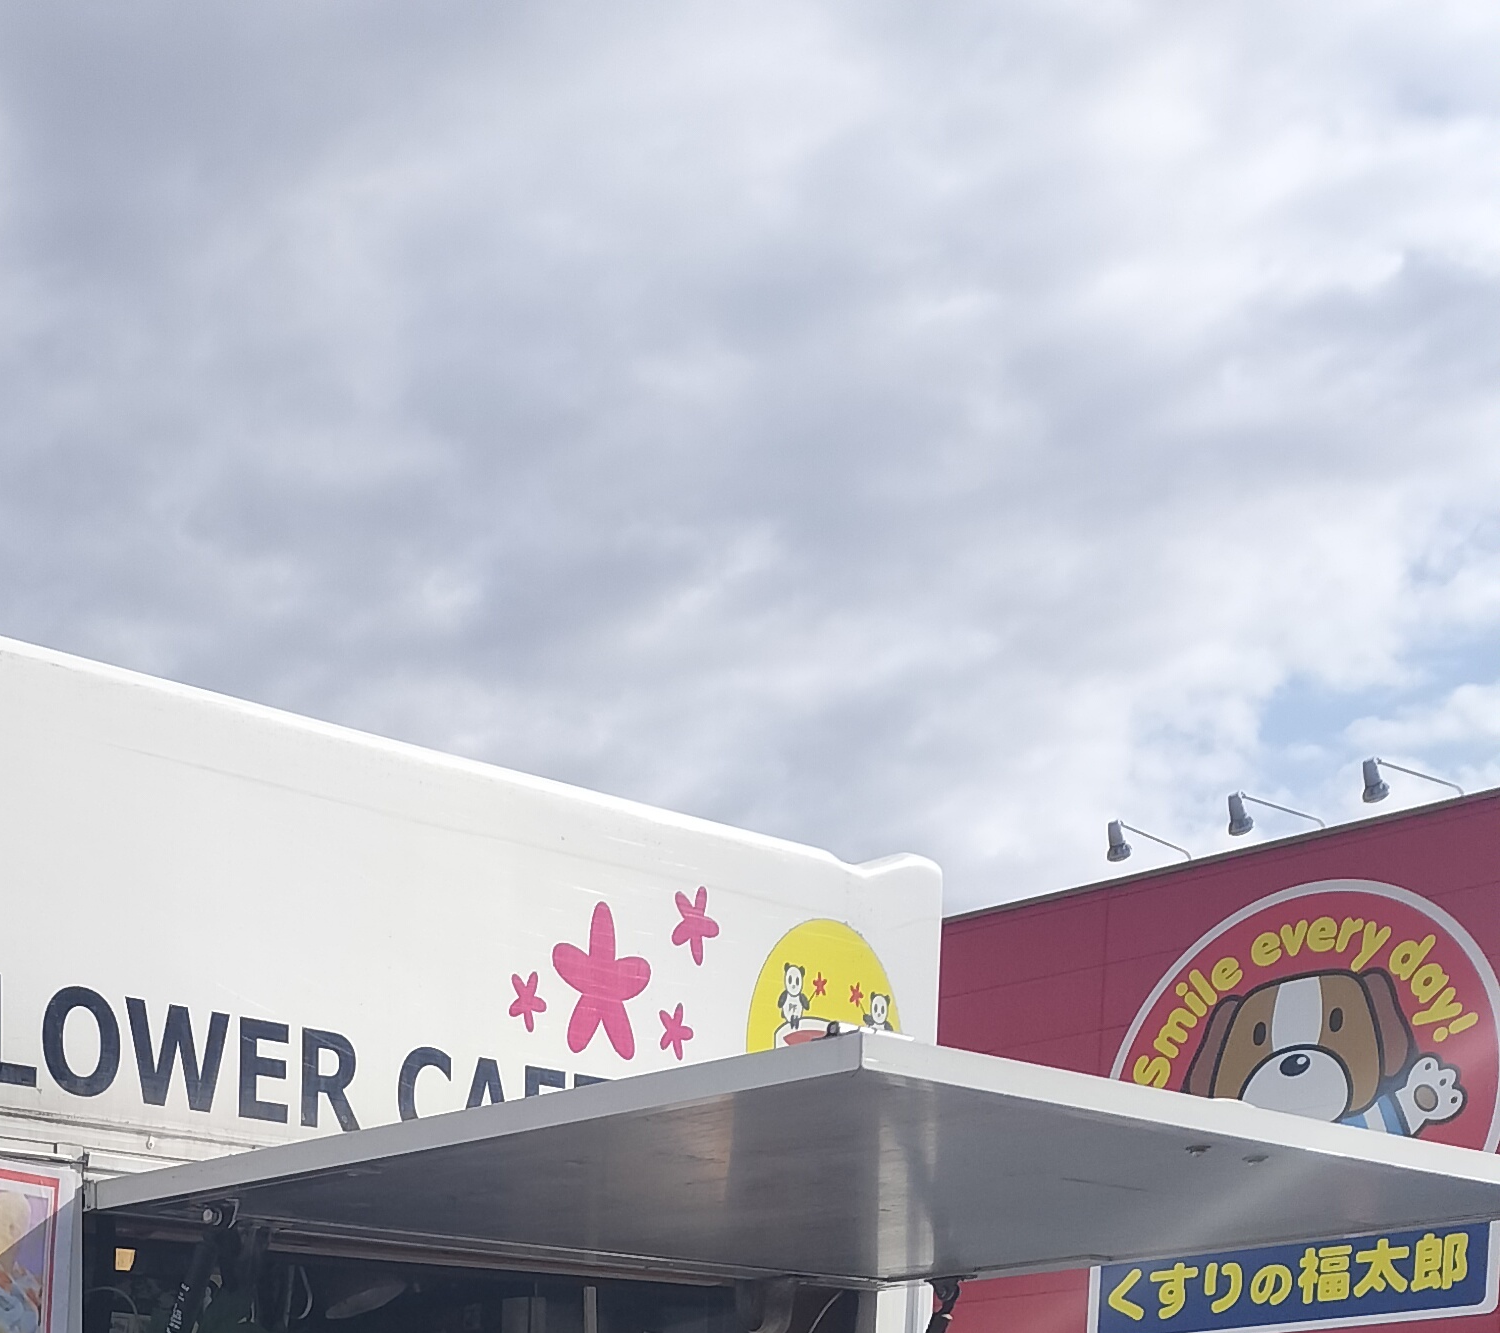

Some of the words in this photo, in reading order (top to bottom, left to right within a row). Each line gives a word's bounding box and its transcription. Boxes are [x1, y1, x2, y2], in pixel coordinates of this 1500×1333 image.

[1251, 916, 1392, 972] every
[1389, 934, 1479, 1043] day!
[398, 1046, 616, 1122] CA
[1108, 1232, 1469, 1321] くすりの福太郎
